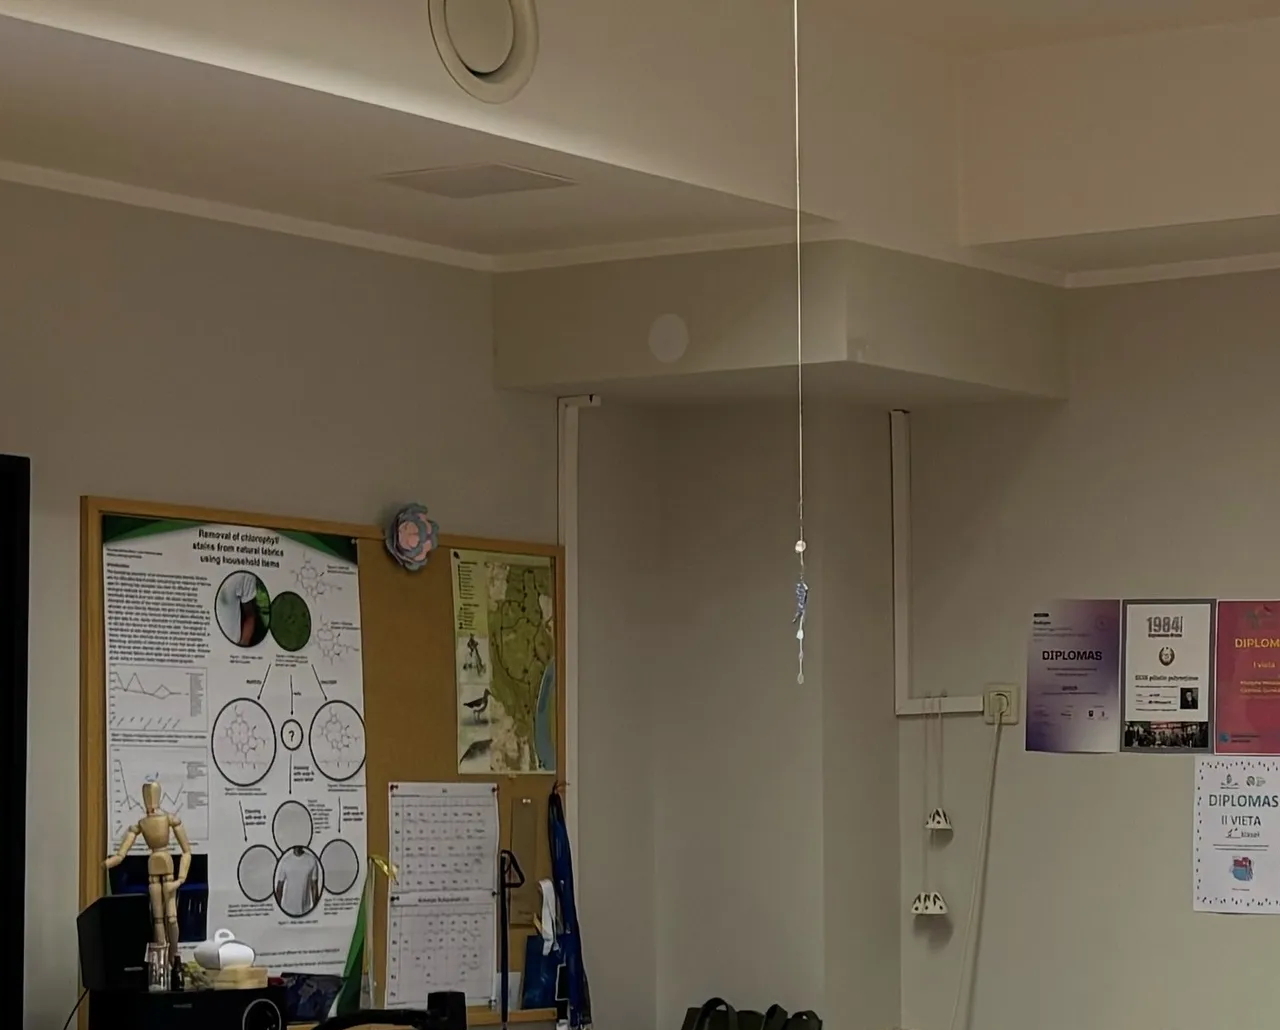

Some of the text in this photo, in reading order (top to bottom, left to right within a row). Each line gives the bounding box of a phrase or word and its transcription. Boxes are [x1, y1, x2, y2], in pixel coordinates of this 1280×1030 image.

[1042, 650, 1103, 661] DIPLOMAS
[1208, 794, 1279, 808] DIPLOMAS
[1221, 815, 1262, 826] II VIETA
